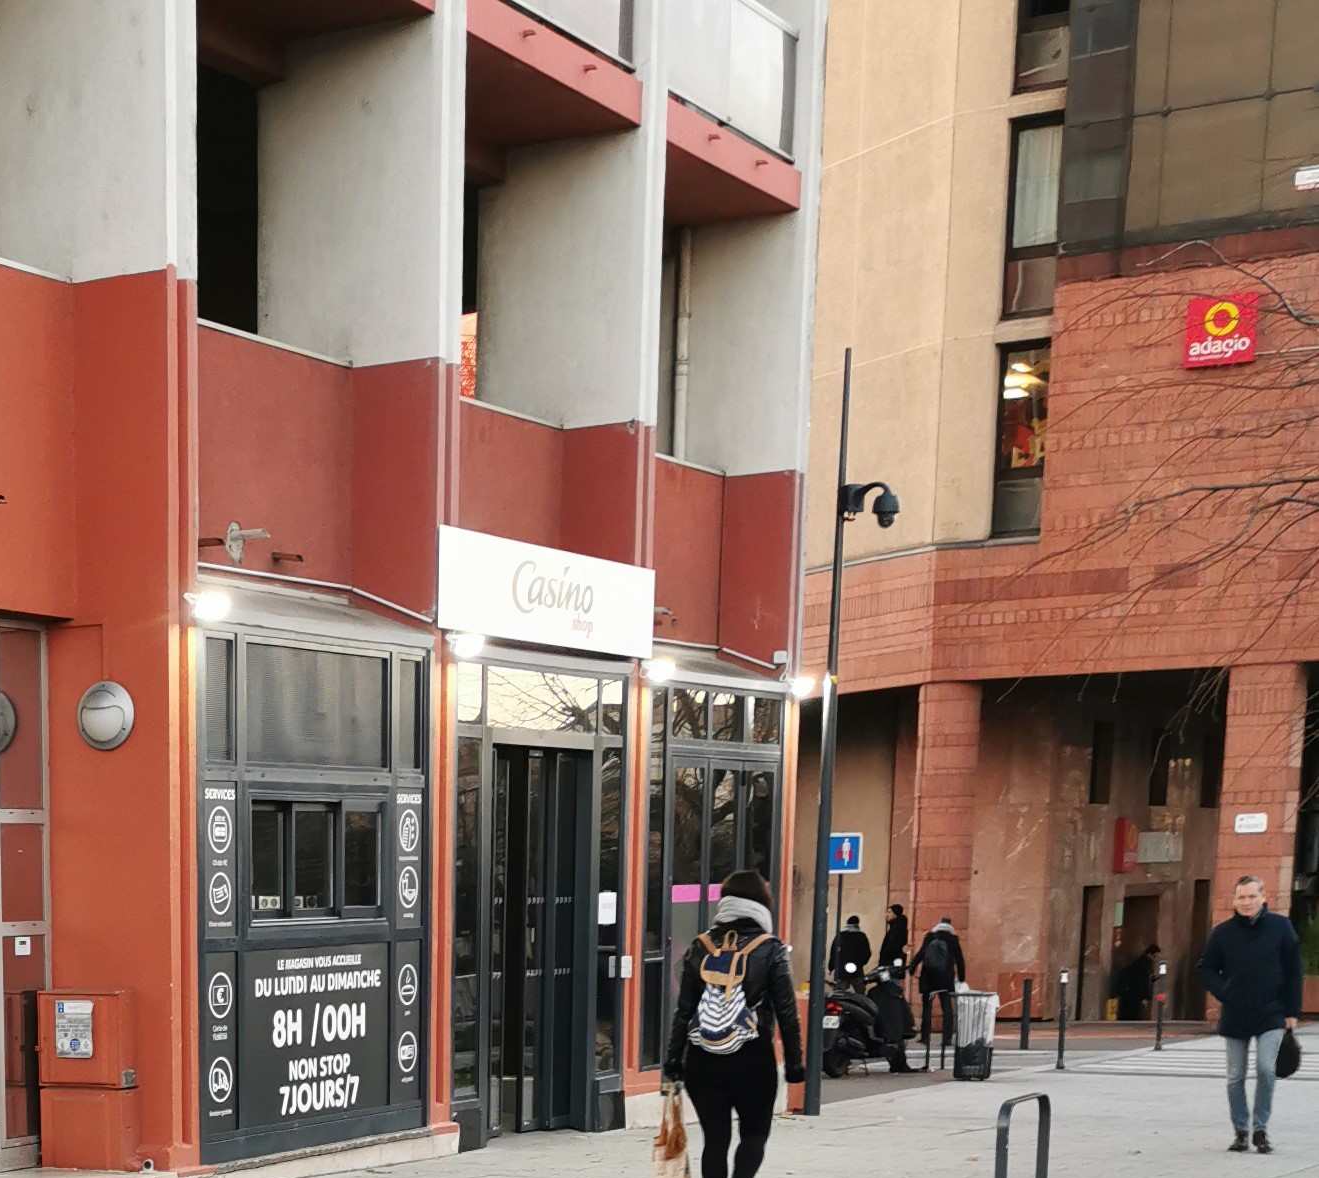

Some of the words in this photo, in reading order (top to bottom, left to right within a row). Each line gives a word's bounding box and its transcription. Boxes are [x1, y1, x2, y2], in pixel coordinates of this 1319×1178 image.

[1189, 333, 1251, 358] adagio
[512, 560, 594, 614] Casino
[571, 613, 593, 639] shop
[205, 787, 236, 800] SERVICES
[277, 959, 285, 971] LE
[285, 957, 314, 970] MAGASIN
[315, 955, 332, 968] VOUS
[332, 953, 362, 966] ACCUEILLE
[255, 978, 272, 998] DU
[274, 975, 307, 996] LUNDI
[310, 974, 326, 993] AU
[327, 969, 381, 992] DIMANCHE
[272, 1008, 302, 1048] 8H
[289, 1057, 318, 1081] NON
[319, 1053, 351, 1077] STOP
